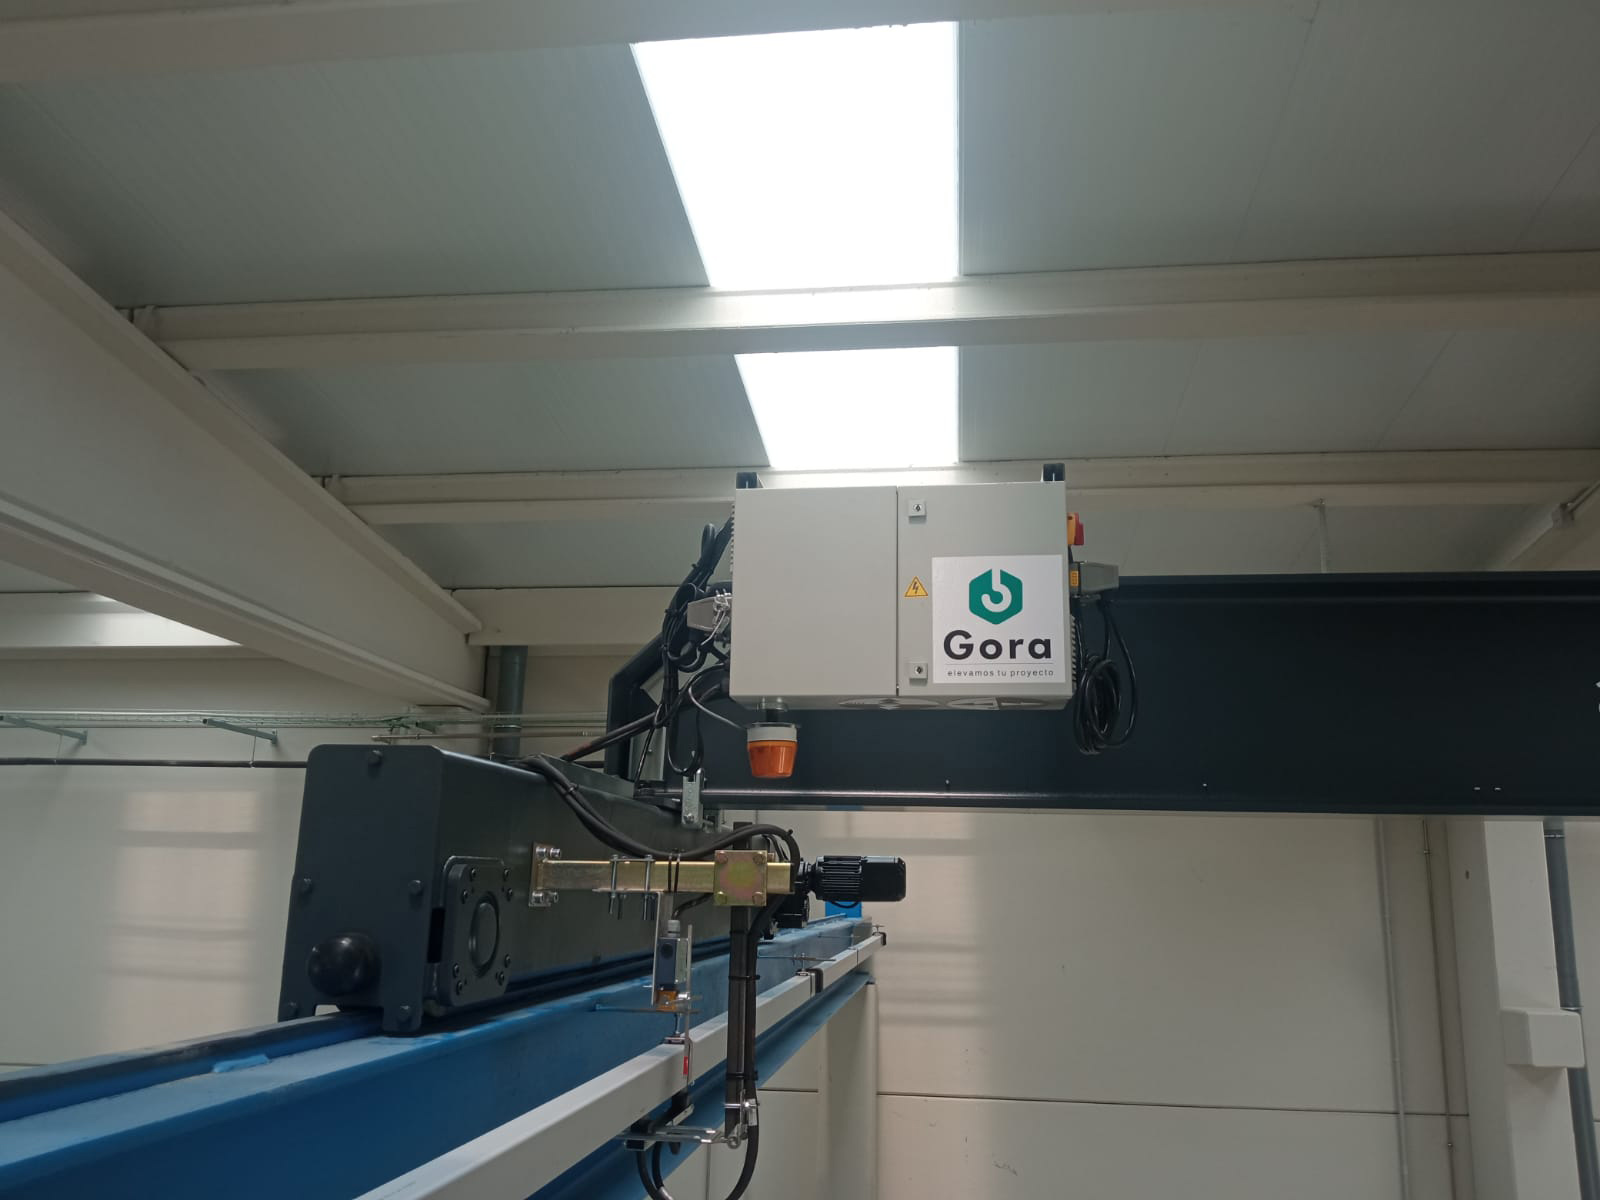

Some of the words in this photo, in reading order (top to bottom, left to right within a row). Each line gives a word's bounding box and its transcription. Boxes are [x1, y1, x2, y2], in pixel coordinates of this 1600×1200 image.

[943, 629, 1052, 660] Gora
[947, 669, 994, 677] elevamos
[997, 669, 1007, 677] tu
[1010, 669, 1054, 679] proyecto
